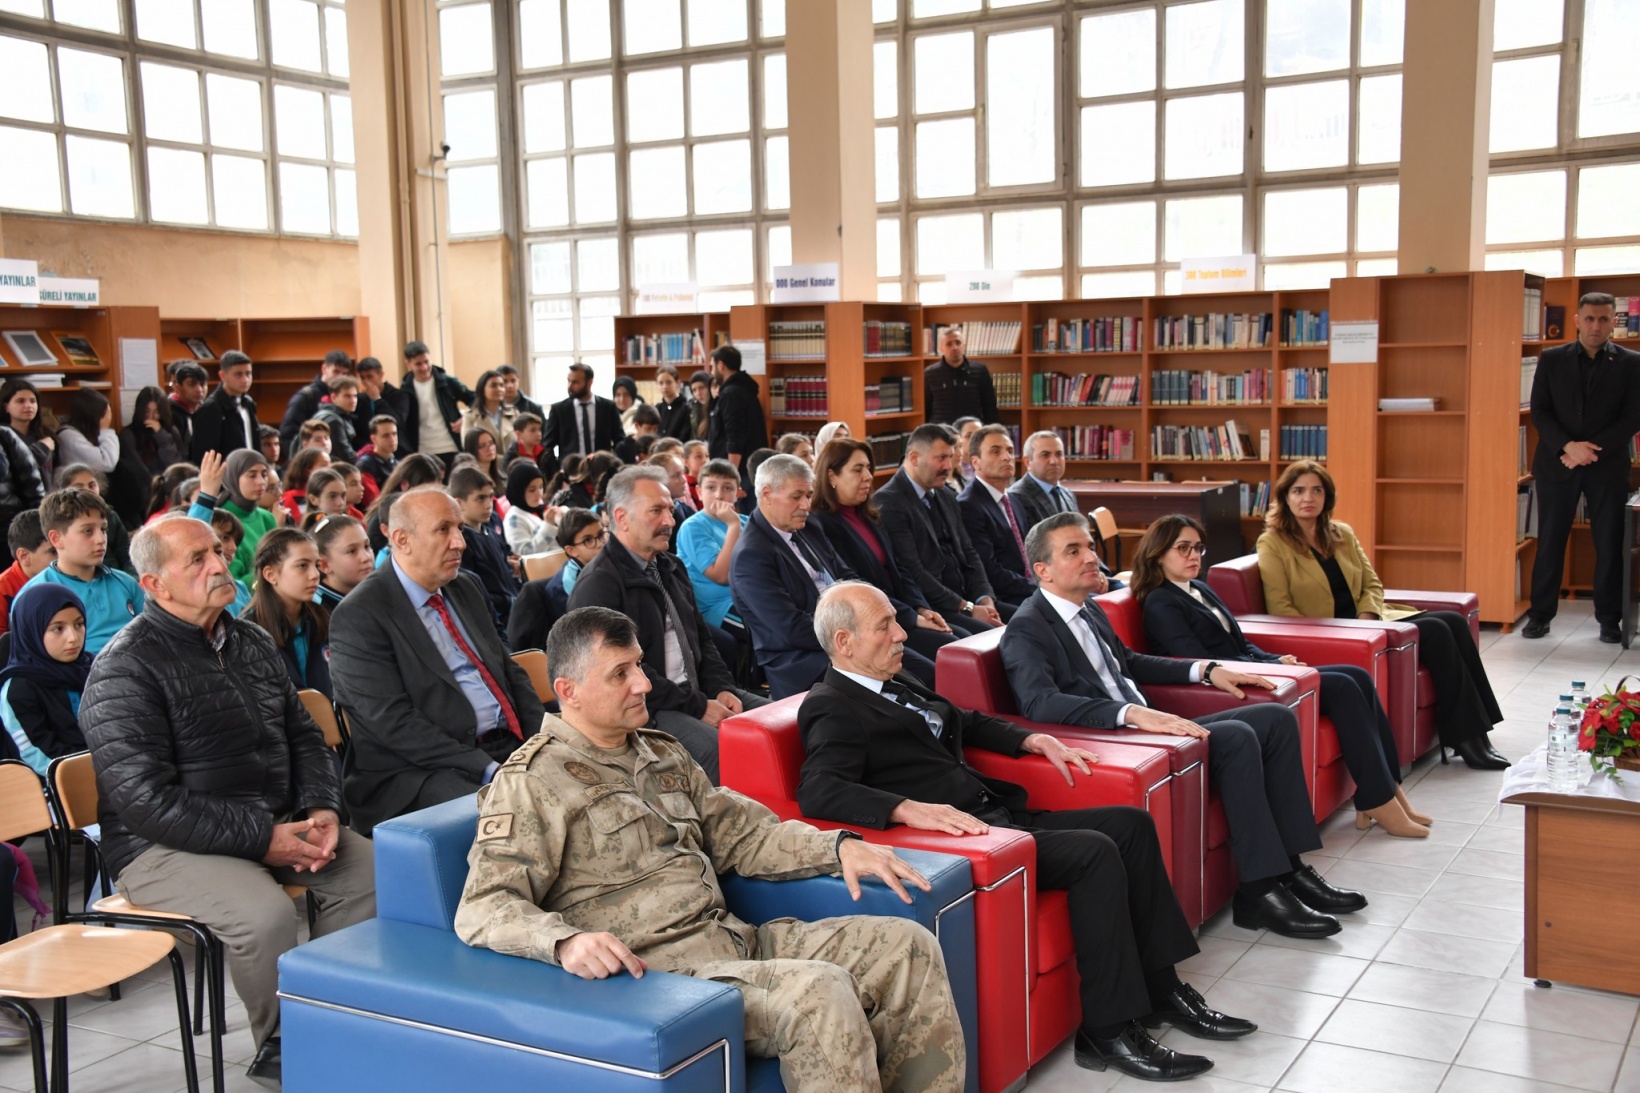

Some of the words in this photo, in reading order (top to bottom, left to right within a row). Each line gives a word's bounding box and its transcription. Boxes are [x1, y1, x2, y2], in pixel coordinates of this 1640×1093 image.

[790, 278, 808, 288] Genel
[810, 277, 835, 287] Konular
[64, 291, 96, 302] YAYINLAR
